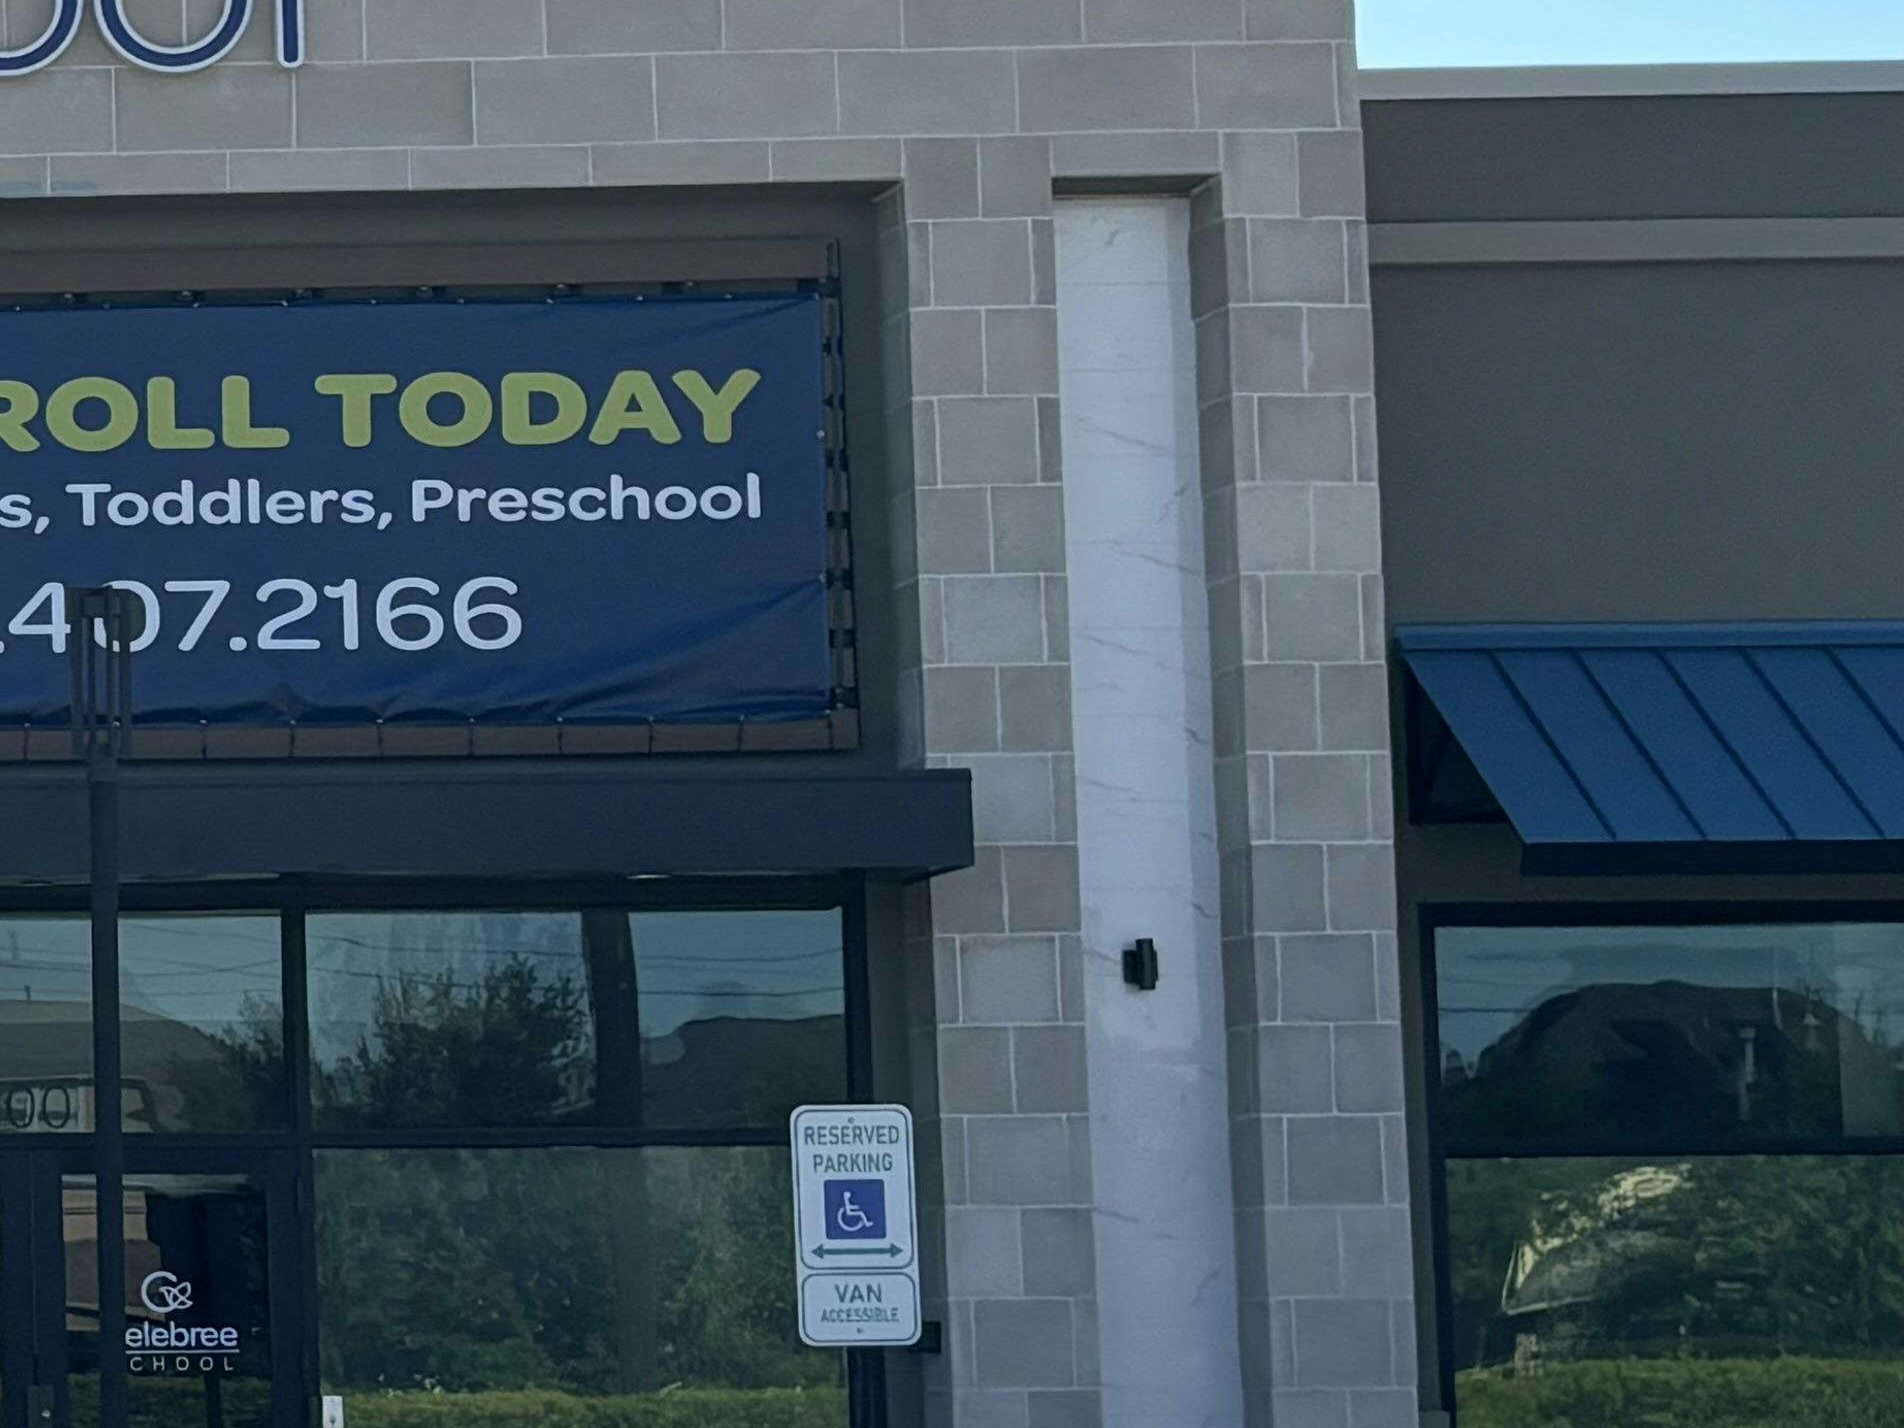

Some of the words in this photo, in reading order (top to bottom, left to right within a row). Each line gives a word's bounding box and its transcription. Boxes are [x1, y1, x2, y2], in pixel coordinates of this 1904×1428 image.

[314, 368, 761, 448] TODAY
[65, 478, 393, 530] Toddlers,
[411, 472, 761, 522] Preschool
[804, 1125, 899, 1145] RESERVED
[813, 1153, 893, 1172] PARKING
[834, 1283, 883, 1304] VAN
[124, 1320, 238, 1348] elebree
[129, 1355, 234, 1372] CHOOL
